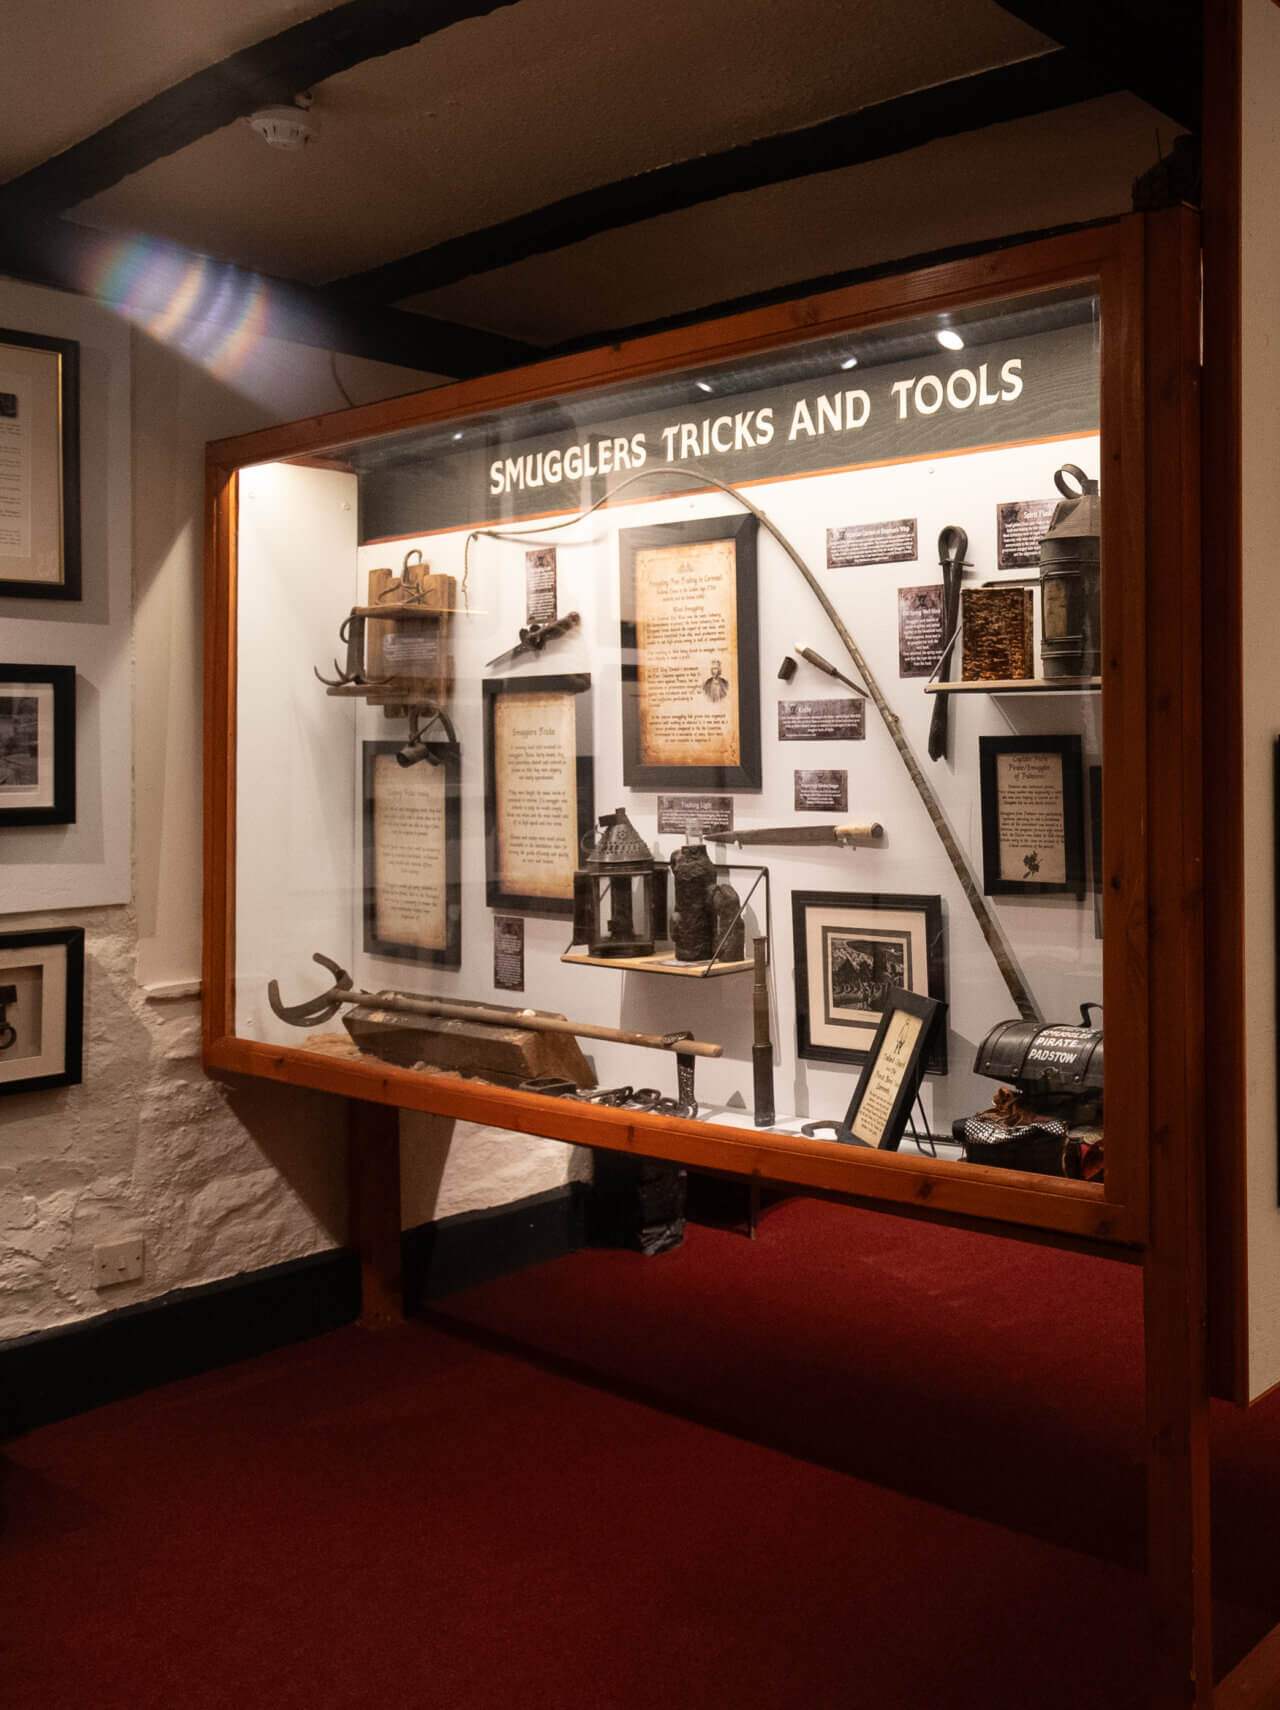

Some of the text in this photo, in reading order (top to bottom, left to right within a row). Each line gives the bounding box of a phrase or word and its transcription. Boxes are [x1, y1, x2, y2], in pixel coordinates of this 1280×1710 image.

[489, 358, 1024, 496] SMUGGLERS TRICKS AND TOOLS
[1035, 1036, 1081, 1048] PIRATE
[1027, 1048, 1078, 1064] PADSTOW
